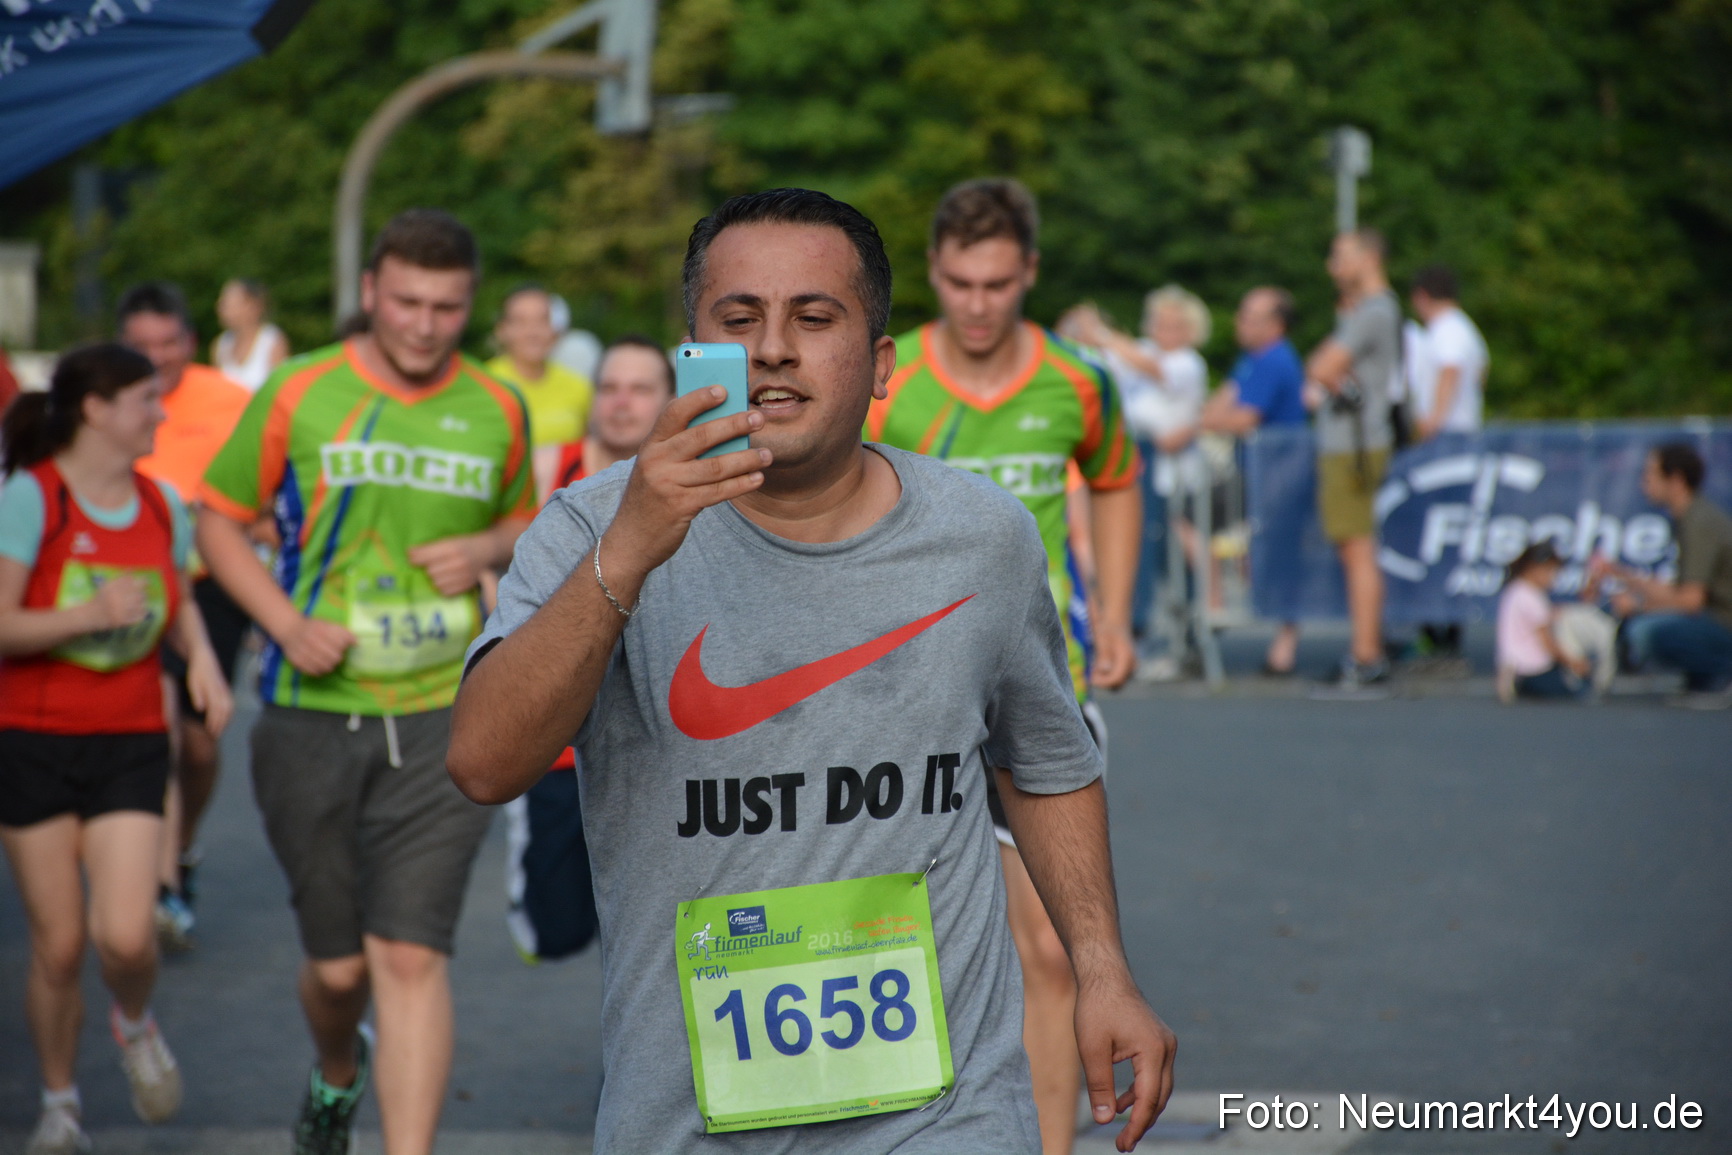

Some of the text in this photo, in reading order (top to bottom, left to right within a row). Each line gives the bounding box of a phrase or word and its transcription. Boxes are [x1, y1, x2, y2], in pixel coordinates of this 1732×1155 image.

[322, 441, 494, 501] BOCK
[945, 453, 1069, 496] CK
[1420, 500, 1678, 566] Fische
[377, 607, 449, 648] 134
[677, 752, 963, 838] JUST DO IT.
[715, 925, 804, 953] firmenlauf
[734, 913, 761, 924] Fischer
[715, 948, 755, 959] neumarkt
[807, 929, 854, 951] 2016
[713, 968, 918, 1062] 1658
